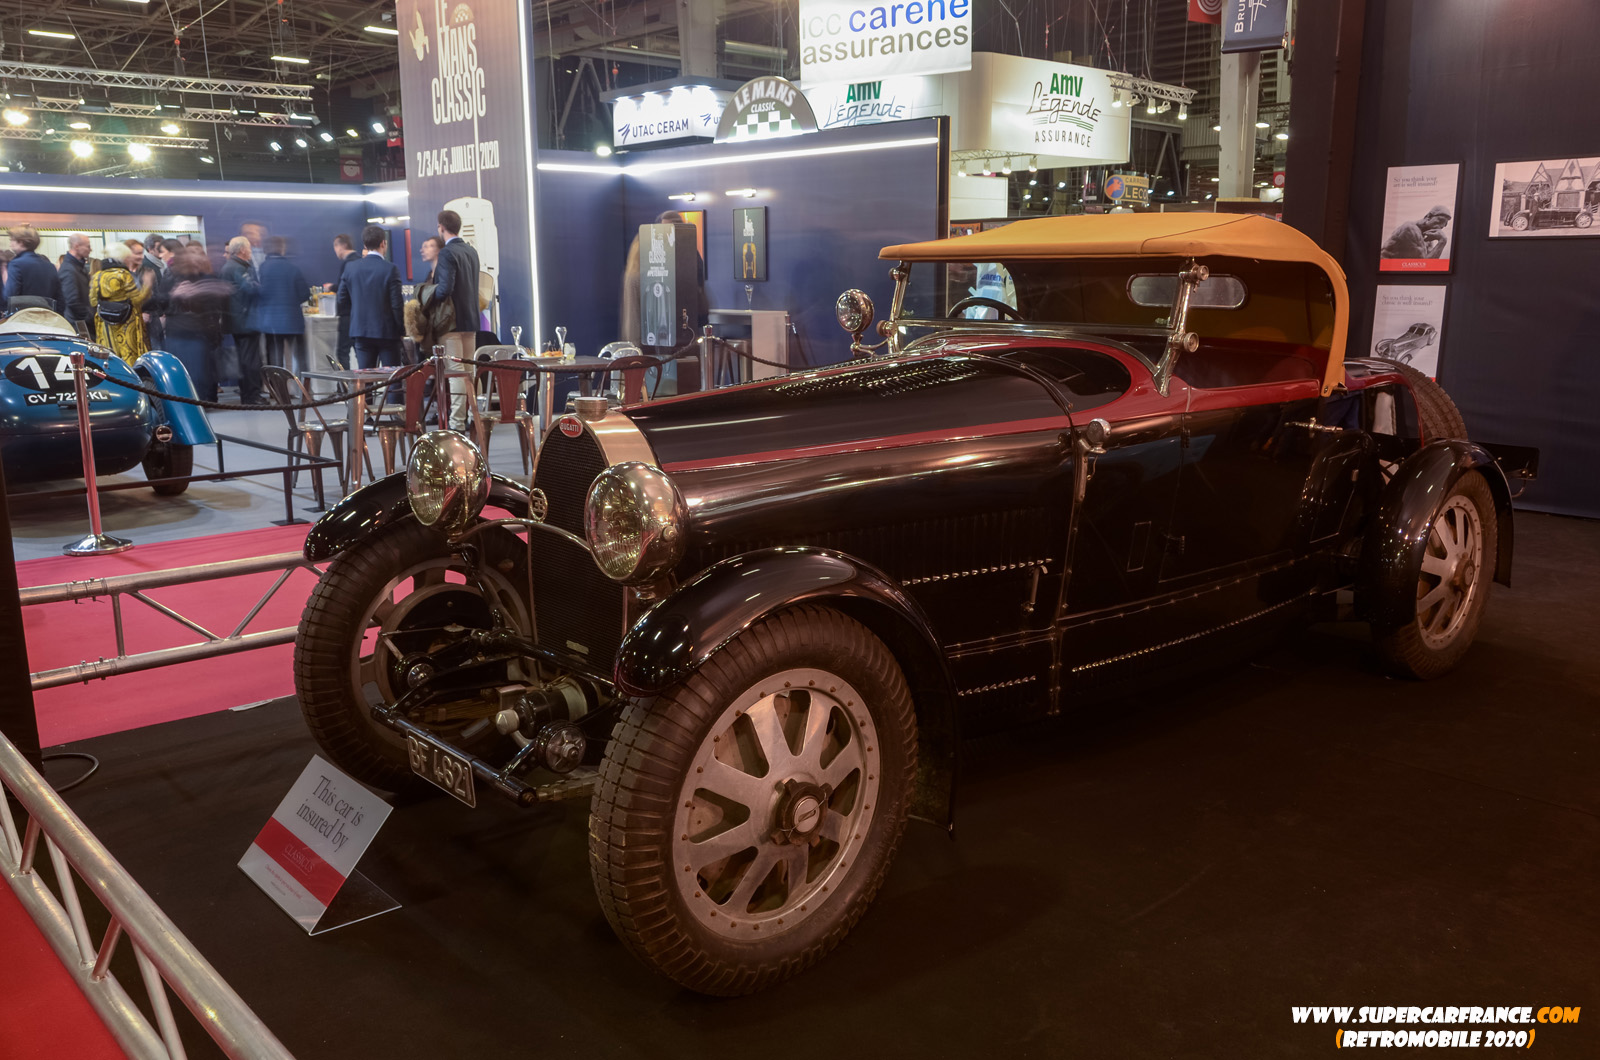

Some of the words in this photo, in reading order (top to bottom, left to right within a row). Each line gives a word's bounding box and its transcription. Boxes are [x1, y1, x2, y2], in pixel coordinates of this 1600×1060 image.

[435, 0, 449, 32] LE
[802, 13, 842, 39] ICC
[1234, 0, 1246, 33] BRU
[437, 23, 478, 78] MANS
[802, 25, 968, 65] assurances
[432, 67, 487, 125] CLASSIC
[734, 87, 751, 114] LE
[752, 80, 796, 108] MANS
[751, 101, 776, 113] CLASSIC
[632, 124, 654, 137] UTAC
[657, 118, 688, 134] CERAM
[1034, 129, 1091, 148] ASSURANCE
[417, 148, 449, 177] 2/3/4/5
[450, 144, 476, 174] JUILLET
[480, 140, 500, 169] 2020
[16, 357, 90, 389] 14
[560, 422, 579, 433] BUGATTI
[408, 735, 429, 773] BF
[433, 749, 471, 800] 4621
[313, 775, 337, 806] This
[334, 799, 354, 819] car
[351, 806, 364, 827] is
[296, 799, 340, 839] insured
[332, 822, 349, 853] by
